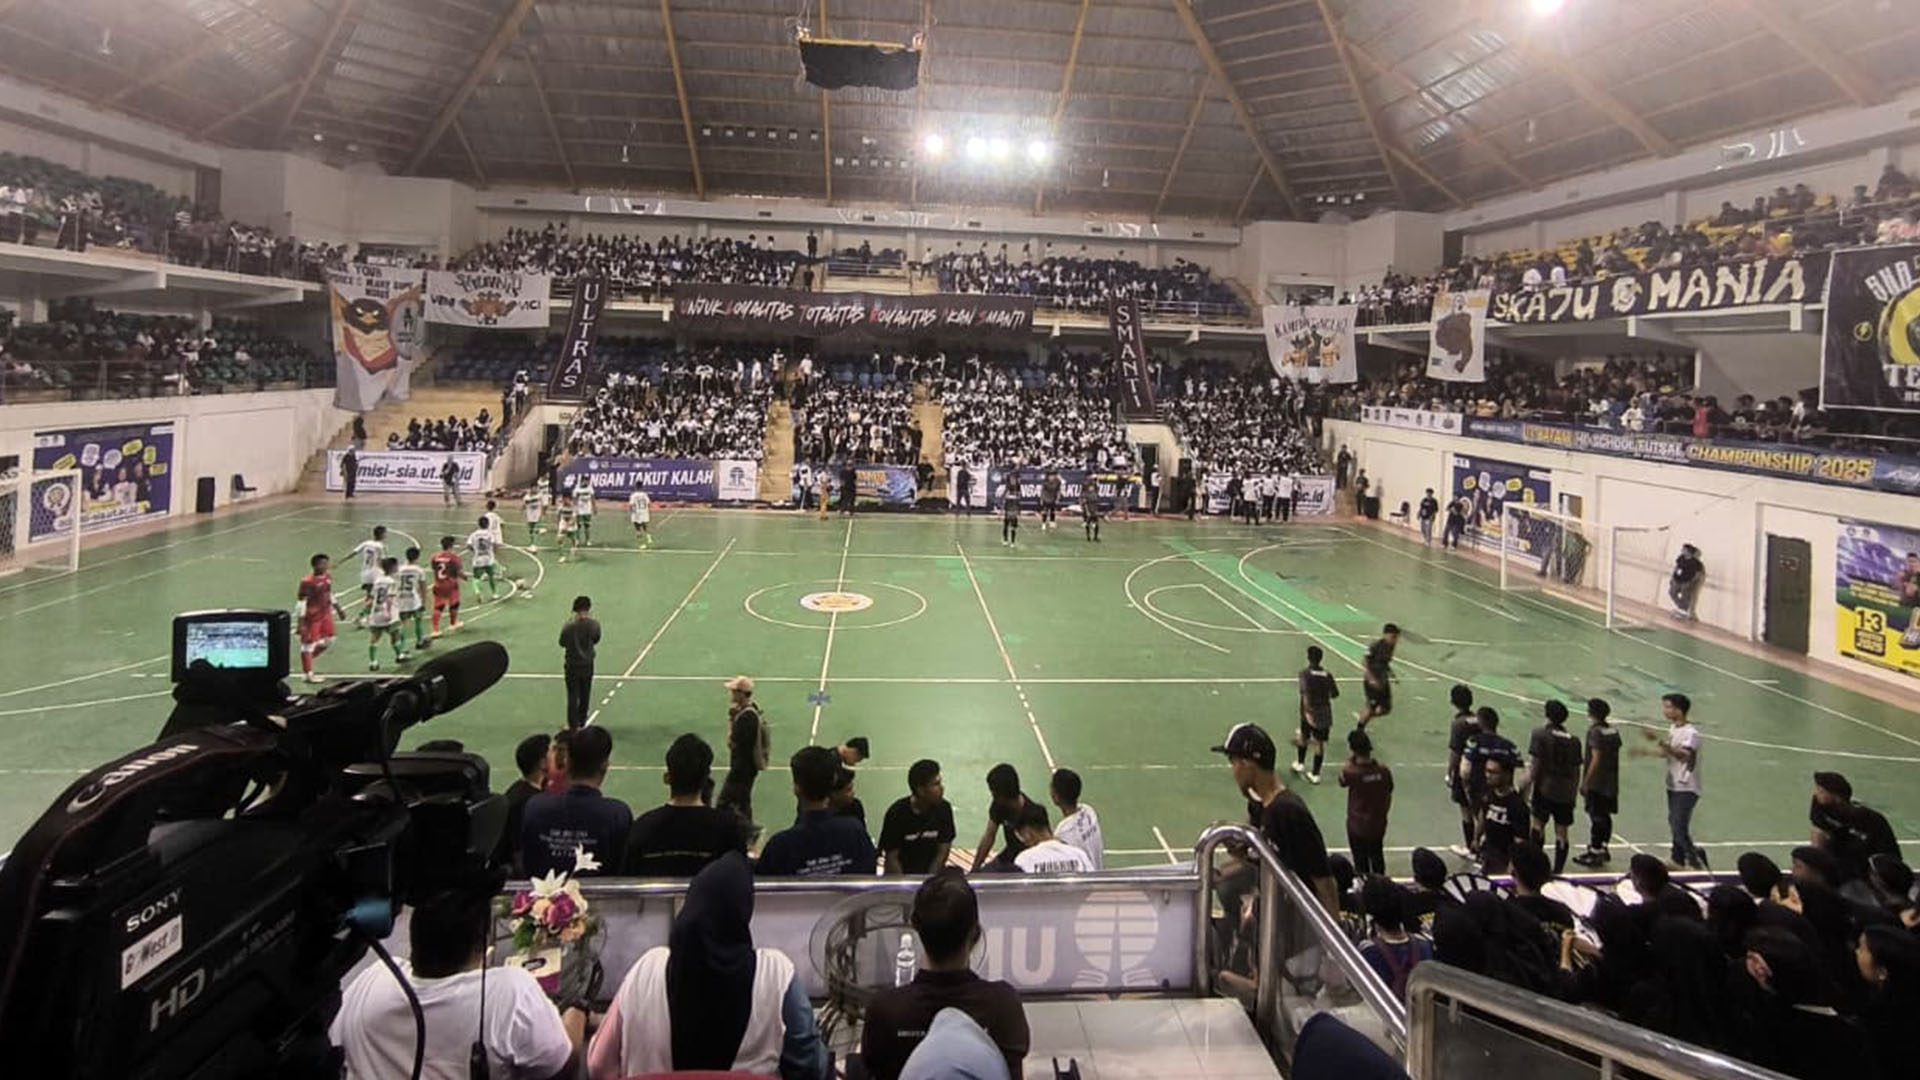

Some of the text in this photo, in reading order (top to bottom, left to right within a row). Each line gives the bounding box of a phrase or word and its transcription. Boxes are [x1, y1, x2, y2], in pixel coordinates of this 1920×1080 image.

[1648, 258, 1806, 311] MANIA
[561, 284, 600, 388] ULTRAS
[798, 304, 865, 328] TOTALITAS
[1117, 306, 1141, 408] SMANTI
[671, 469, 715, 486] KALAH
[1690, 447, 1813, 475] CHAMPIONSHIP
[1814, 457, 1874, 481] 2025
[437, 563, 447, 579] 2
[66, 744, 199, 814] Canon
[126, 886, 183, 933] SONY
[150, 968, 205, 1032] HD
